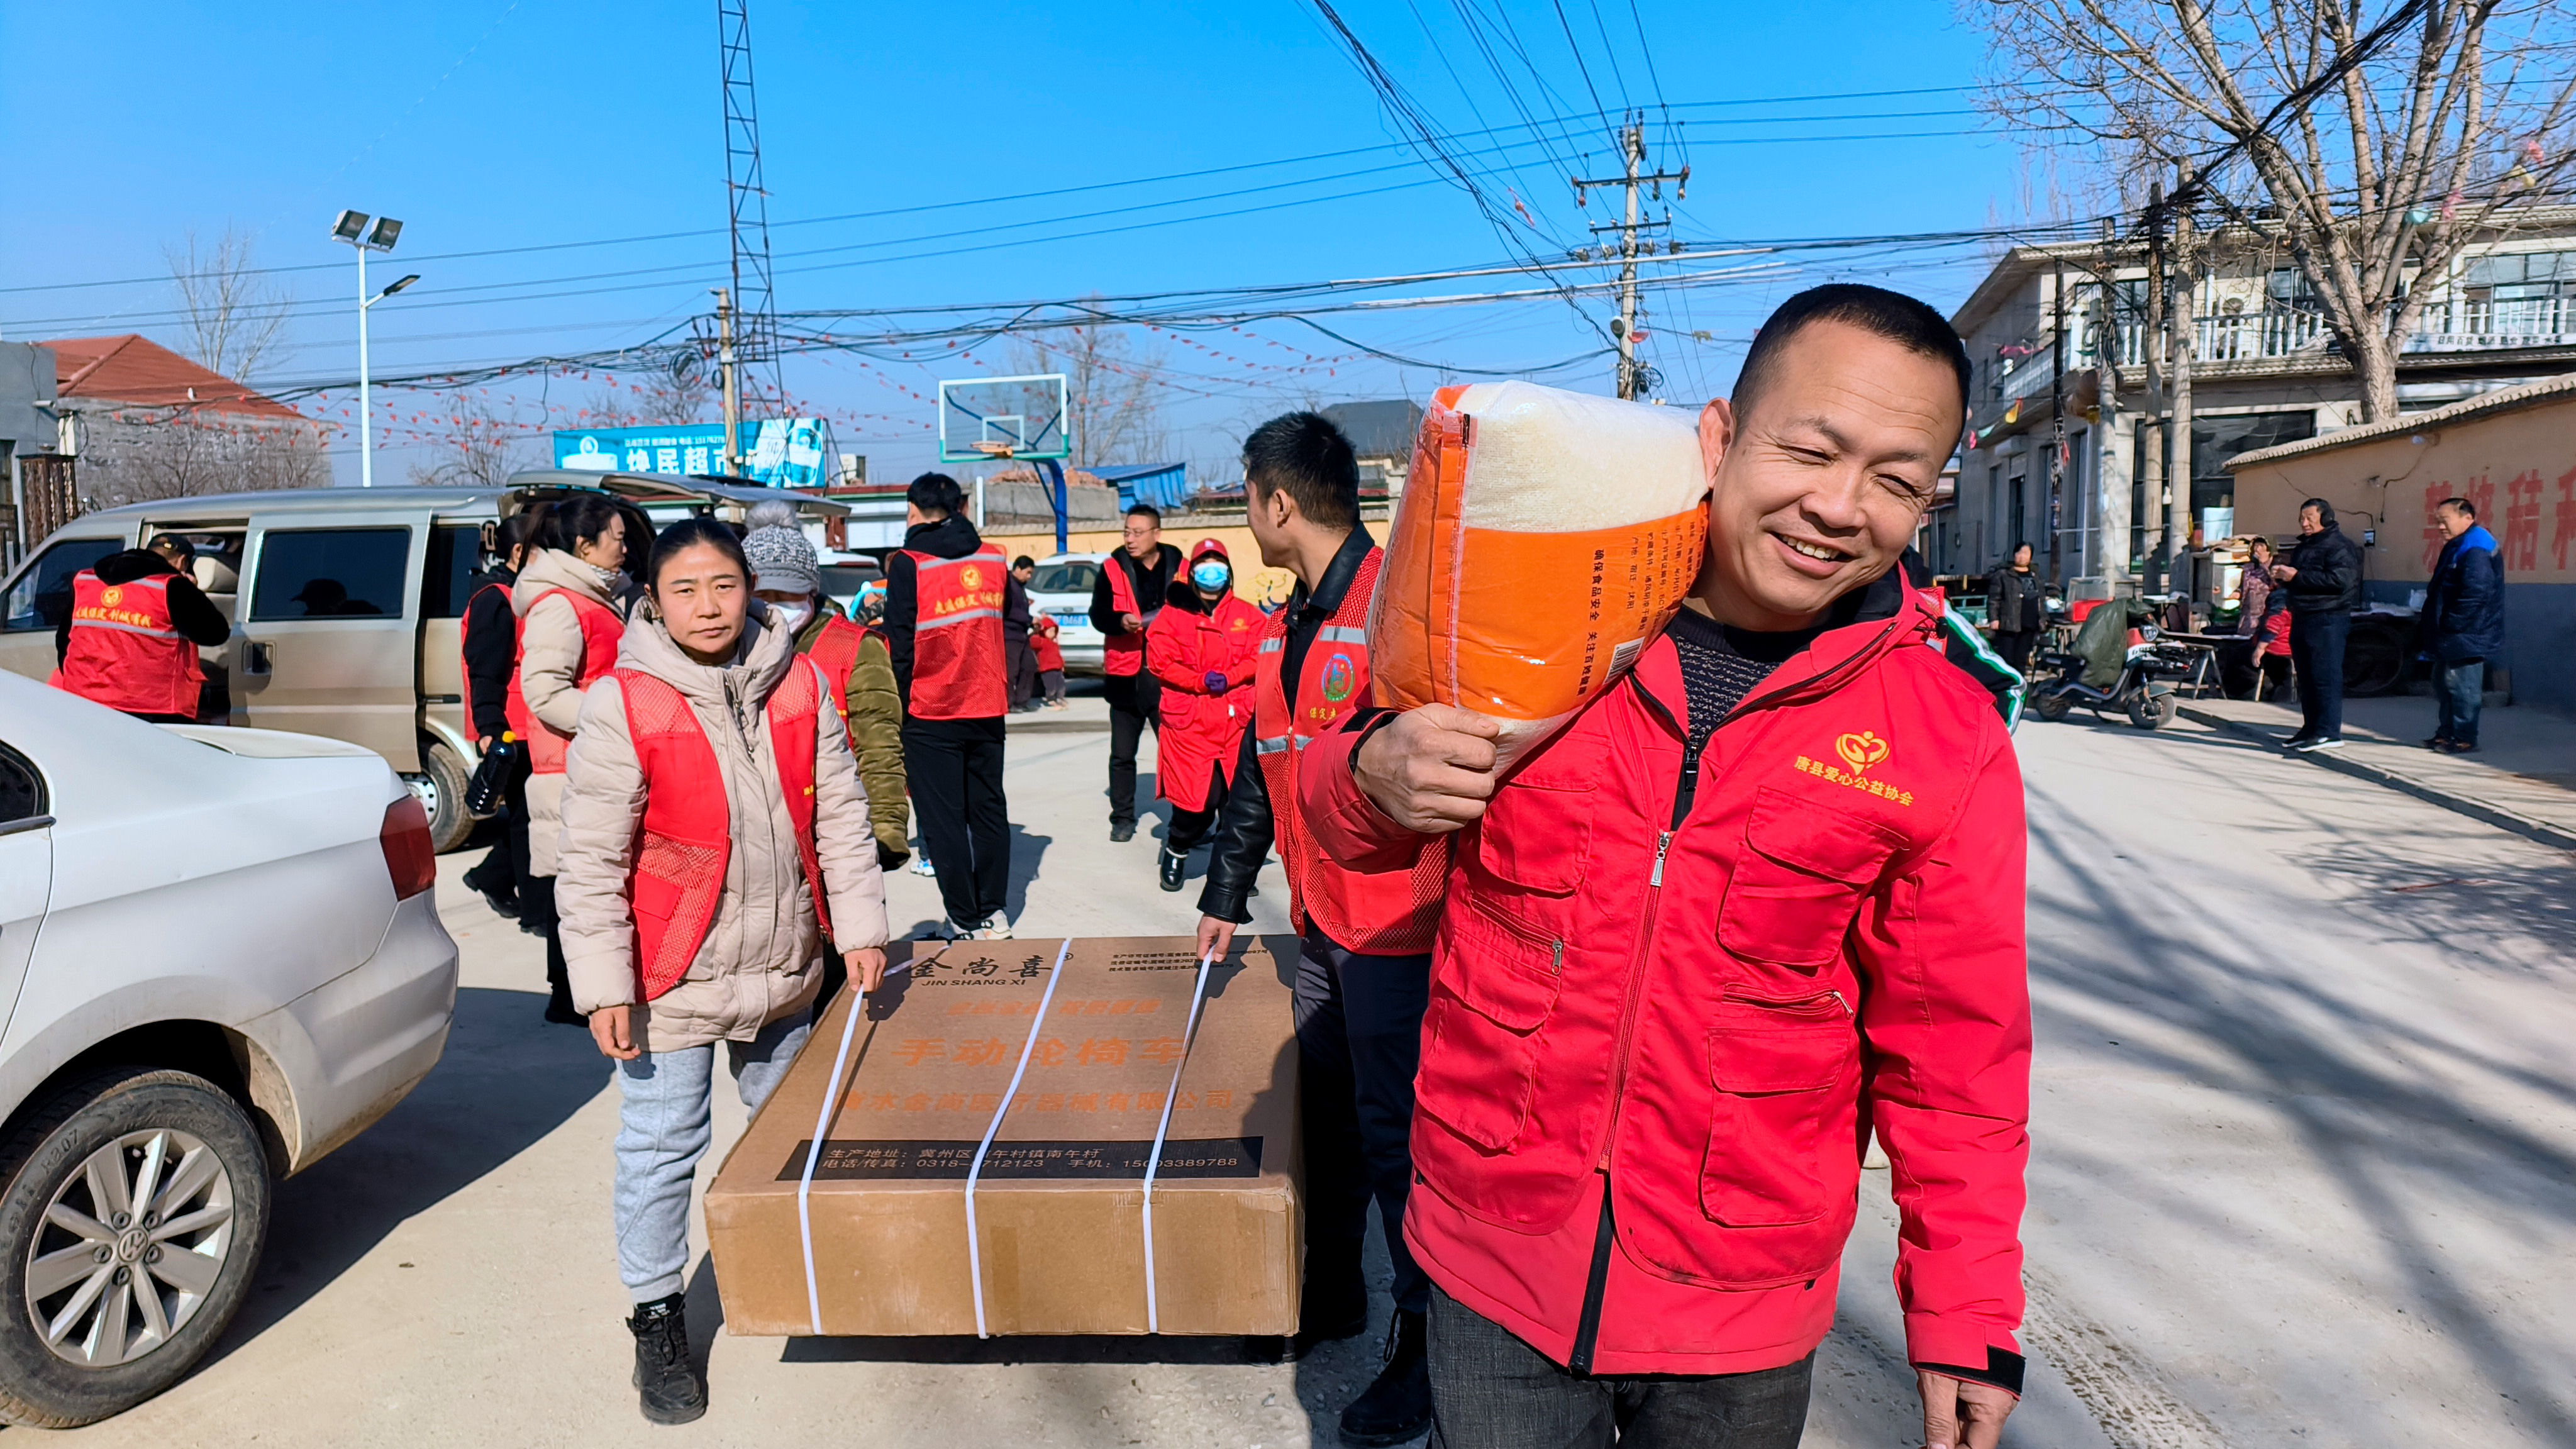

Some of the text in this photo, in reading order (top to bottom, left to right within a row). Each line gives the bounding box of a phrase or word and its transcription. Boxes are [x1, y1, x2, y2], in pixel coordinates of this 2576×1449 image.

[1576, 548, 1605, 696] 确保食品安全 关注百姓健康
[1794, 755, 1914, 807] 唐县爱心公益协会
[908, 954, 1053, 979] 金尚喜
[891, 1036, 1190, 1067] 手动轮椅车
[821, 1158, 1045, 1169] 电话/传真：0318-712123
[826, 1148, 1105, 1159] 生产地址：冀州区午村镇南午村
